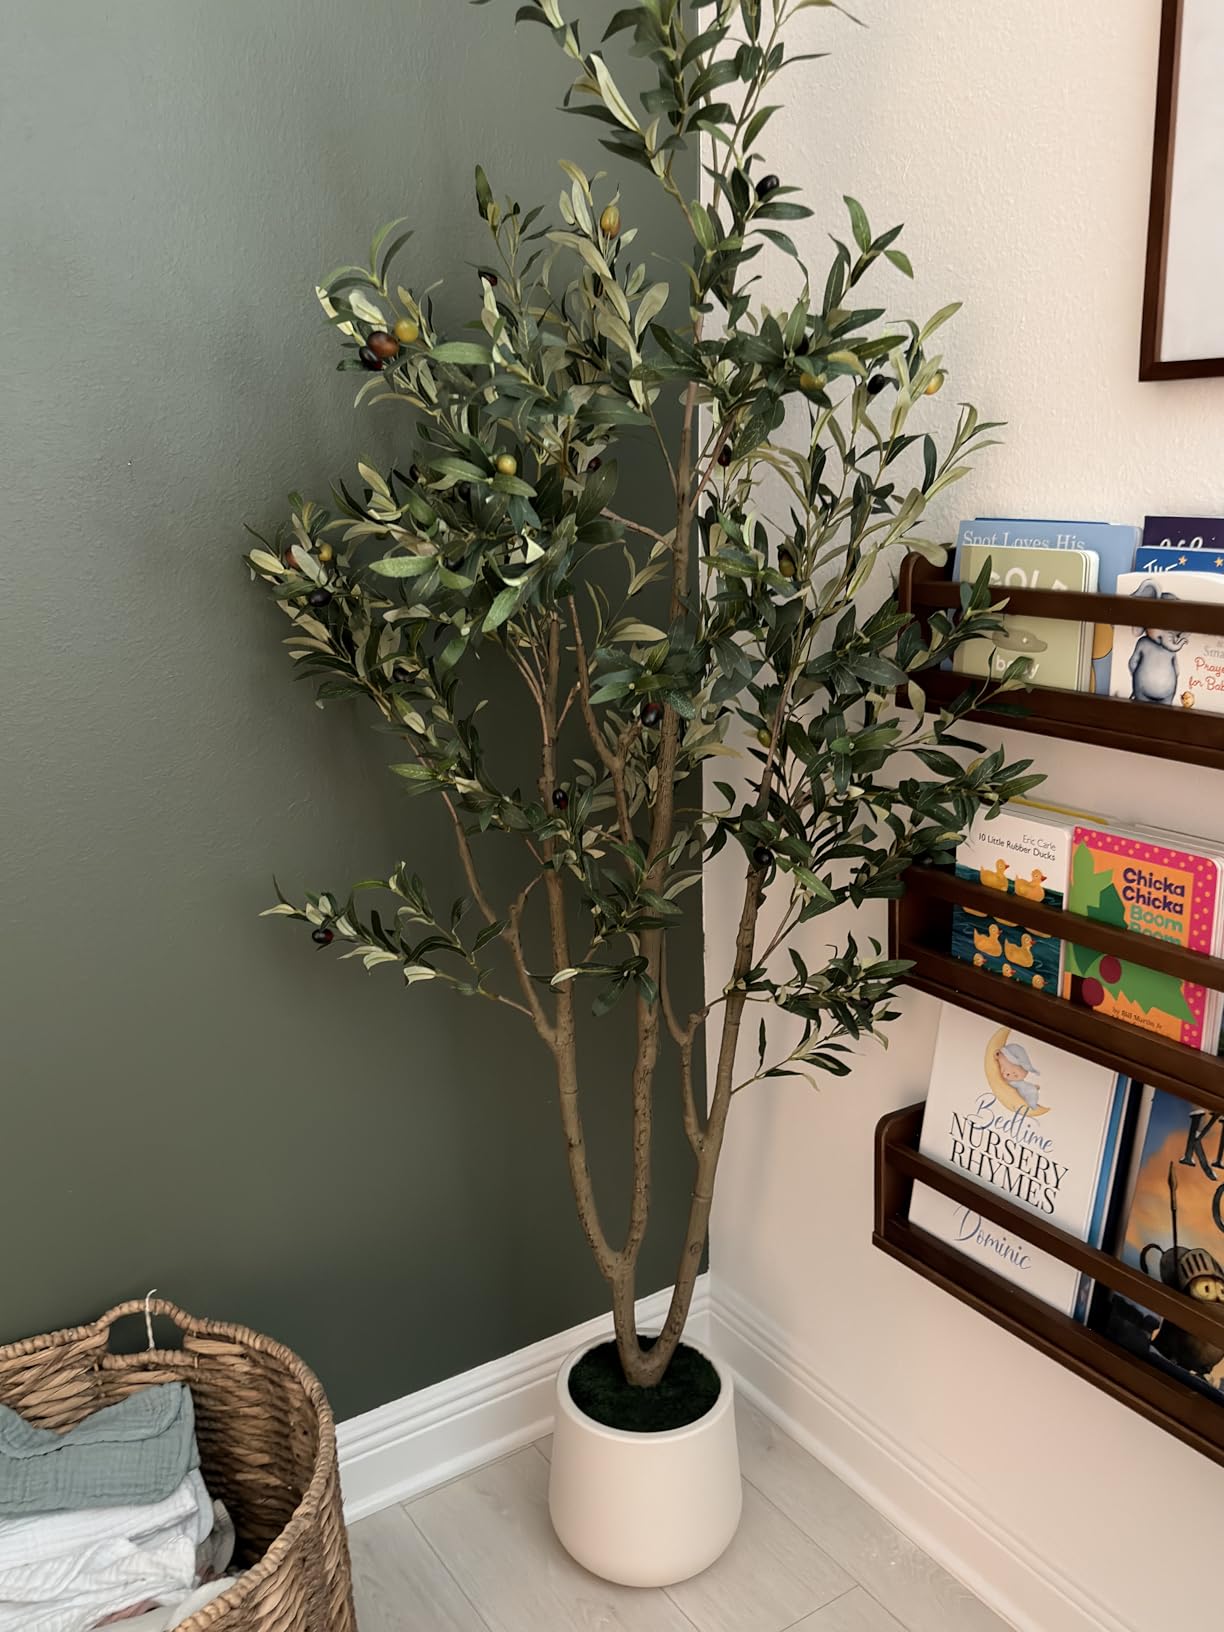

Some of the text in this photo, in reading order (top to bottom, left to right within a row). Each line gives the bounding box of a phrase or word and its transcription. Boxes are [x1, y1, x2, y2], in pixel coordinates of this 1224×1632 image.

[963, 530, 1086, 550] Spot Loves His
[1188, 676, 1203, 690] for
[978, 832, 1056, 861] 10 Little Rubber Ducks
[1022, 834, 1056, 852] Eric Carle
[1122, 867, 1185, 898] Chicka
[1122, 885, 1184, 915] Chicka
[1130, 904, 1183, 934] Boom
[966, 1092, 1055, 1154] Bedtime
[949, 1111, 1069, 1191] NURSERY
[949, 1137, 1058, 1215] RHYMES
[952, 1204, 1032, 1270] Dominic
